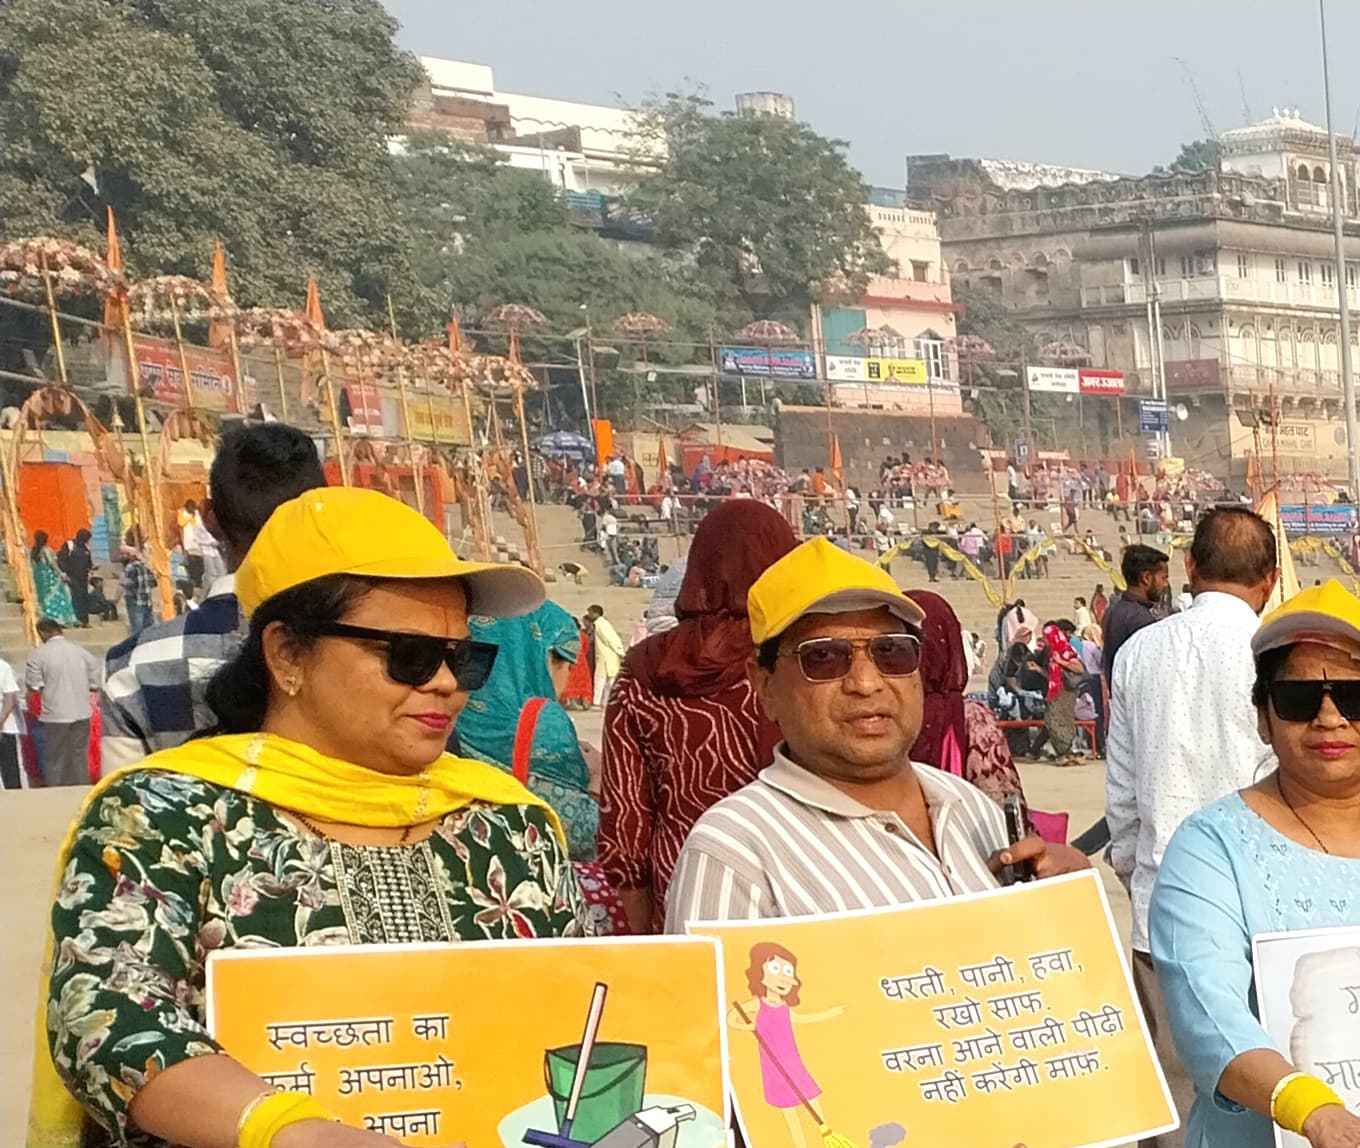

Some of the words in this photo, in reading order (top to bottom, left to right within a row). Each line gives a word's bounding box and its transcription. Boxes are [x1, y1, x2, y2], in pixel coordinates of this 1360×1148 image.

[881, 968, 955, 999] धरती,
[960, 956, 1025, 988] पानी,
[1028, 950, 1083, 980] हवा,
[266, 1017, 394, 1051] स्वच्छता
[412, 1015, 450, 1042] का
[933, 997, 982, 1029] रखो
[882, 1044, 944, 1072] वरना
[952, 1028, 1004, 1063] आने
[1008, 1017, 1066, 1051] वाली
[1071, 1005, 1125, 1038] पीढ़ी
[338, 1055, 463, 1096] अपनाओ,
[920, 1069, 967, 1103] नहीं
[972, 1058, 1040, 1094] करेंगी
